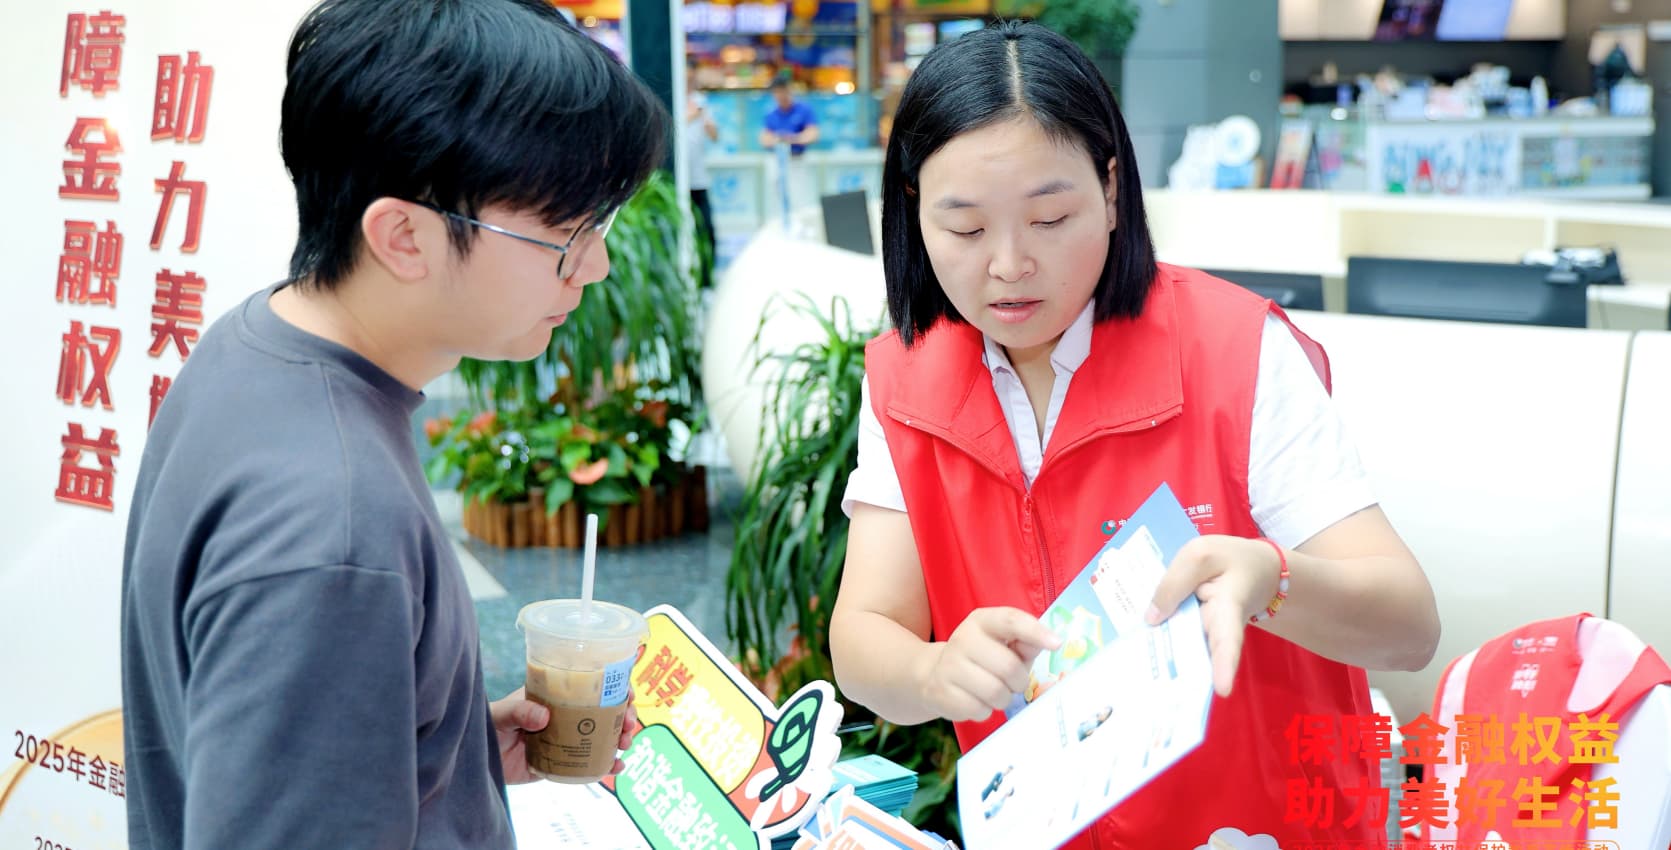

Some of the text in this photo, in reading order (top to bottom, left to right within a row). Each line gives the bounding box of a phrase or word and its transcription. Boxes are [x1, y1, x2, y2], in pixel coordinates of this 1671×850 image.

[55, 10, 126, 512] 障金融权益
[1184, 503, 1212, 516] 发银行
[14, 730, 126, 800] 2025年金融
[620, 736, 737, 850] 和谐金融致
